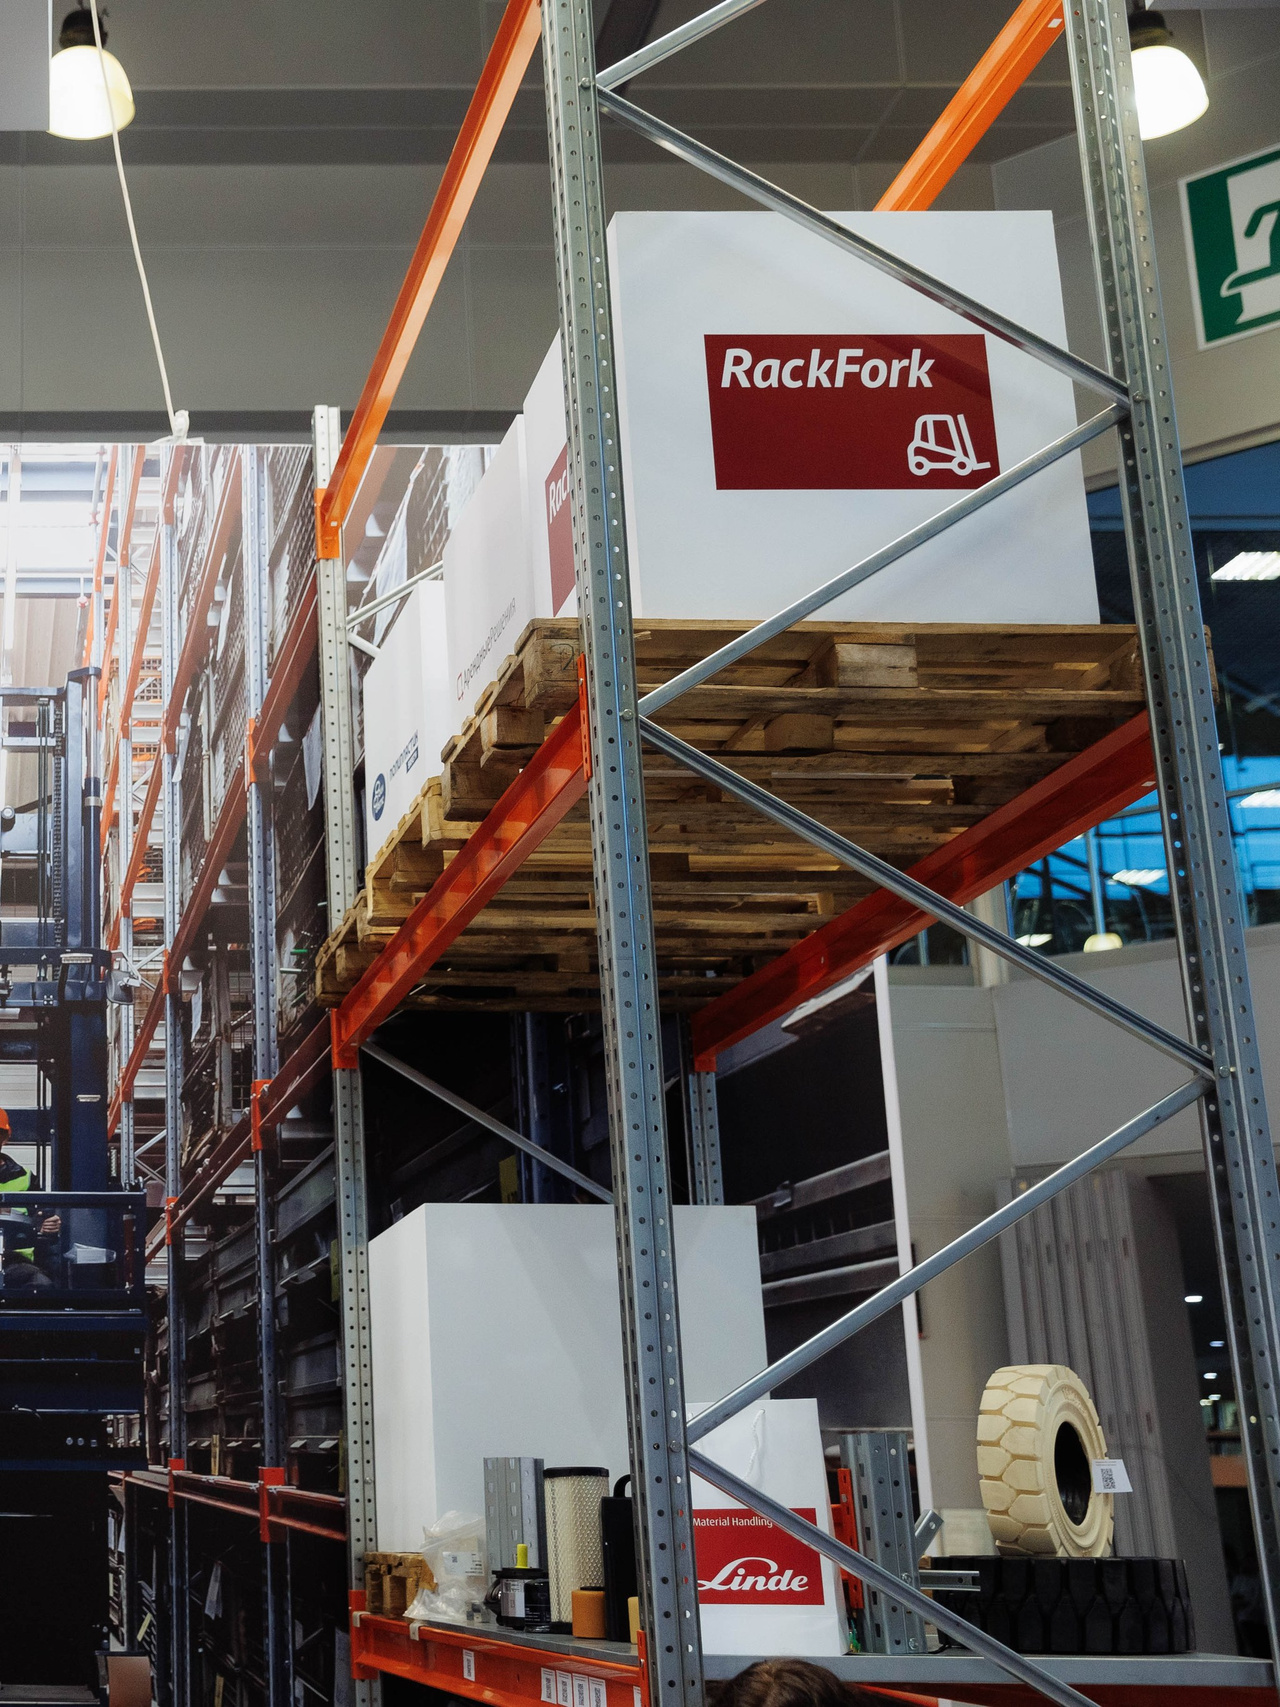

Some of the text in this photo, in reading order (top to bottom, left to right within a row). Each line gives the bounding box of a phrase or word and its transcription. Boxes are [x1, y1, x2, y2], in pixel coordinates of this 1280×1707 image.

[721, 348, 935, 388] RackFork
[692, 1516, 730, 1527] Material
[697, 1556, 809, 1592] Linde
